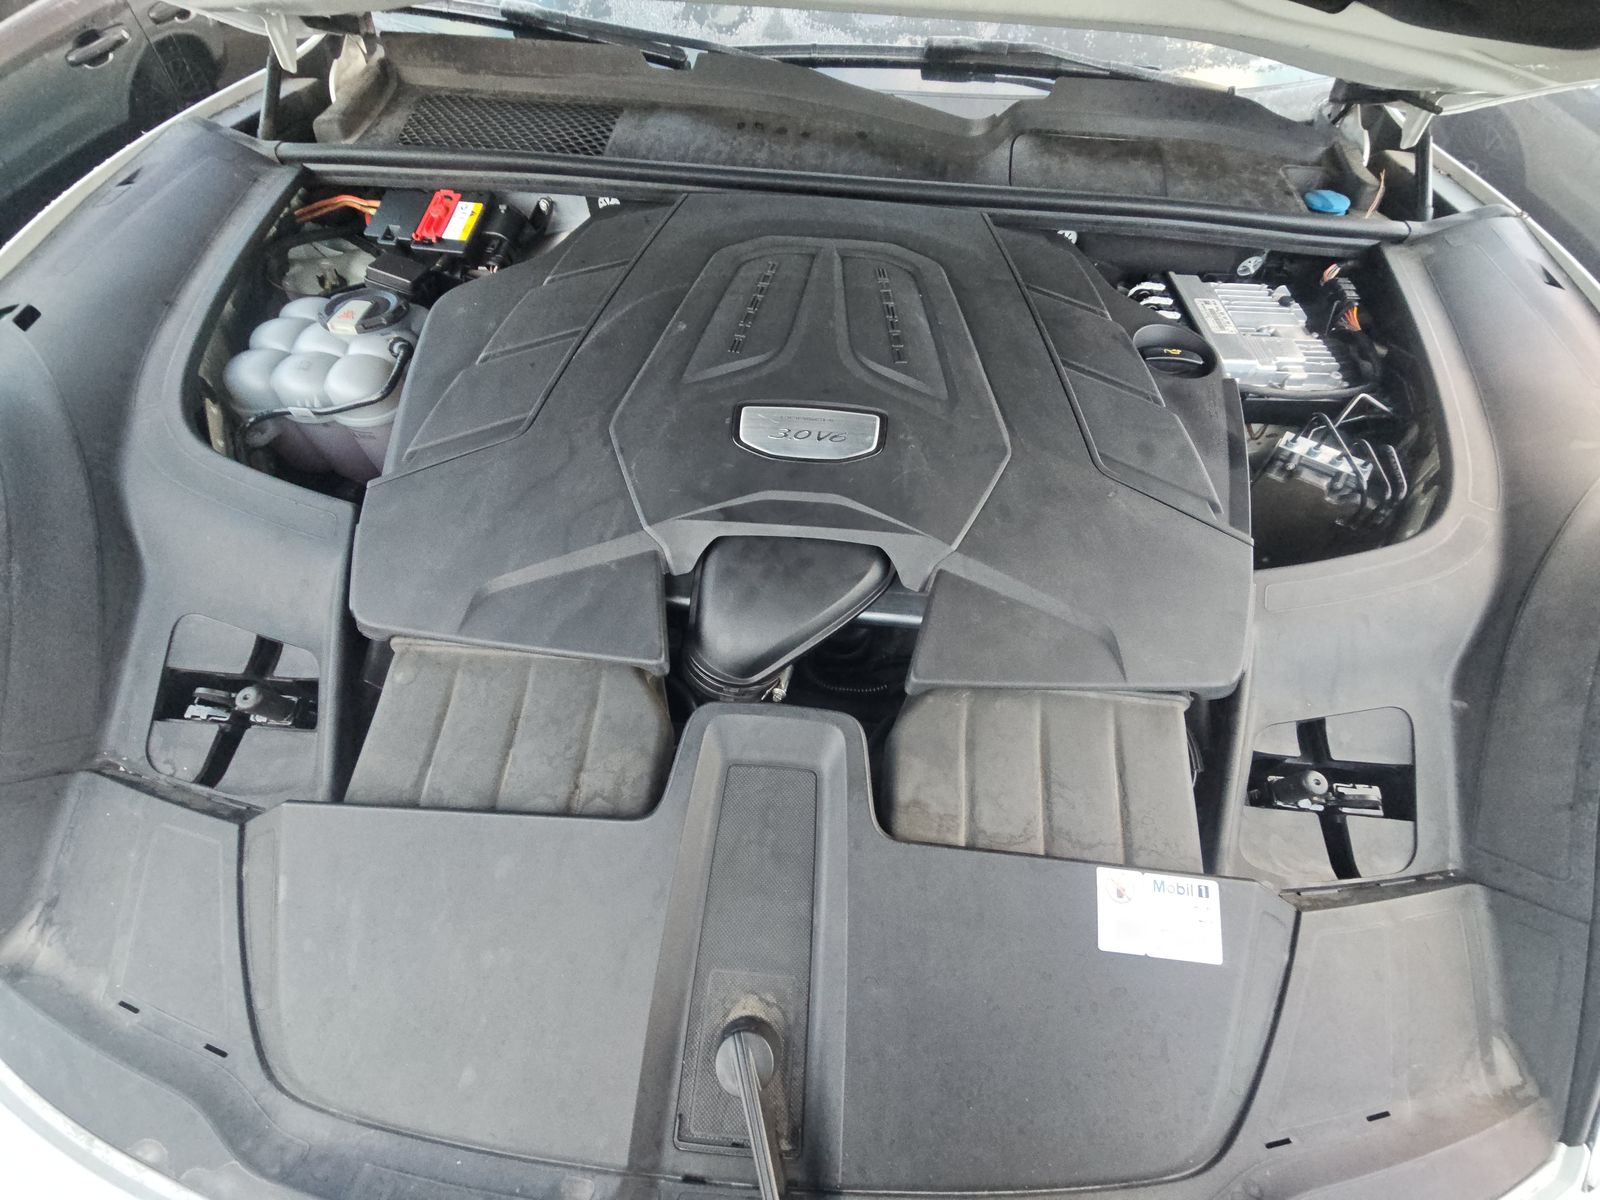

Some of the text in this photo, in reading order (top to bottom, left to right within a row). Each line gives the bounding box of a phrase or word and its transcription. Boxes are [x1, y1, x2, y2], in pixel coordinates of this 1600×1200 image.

[727, 261, 777, 354] PORSCHE
[875, 267, 908, 364] PORSCHE
[816, 430, 847, 443] V6
[1153, 879, 1194, 897] Mobil
